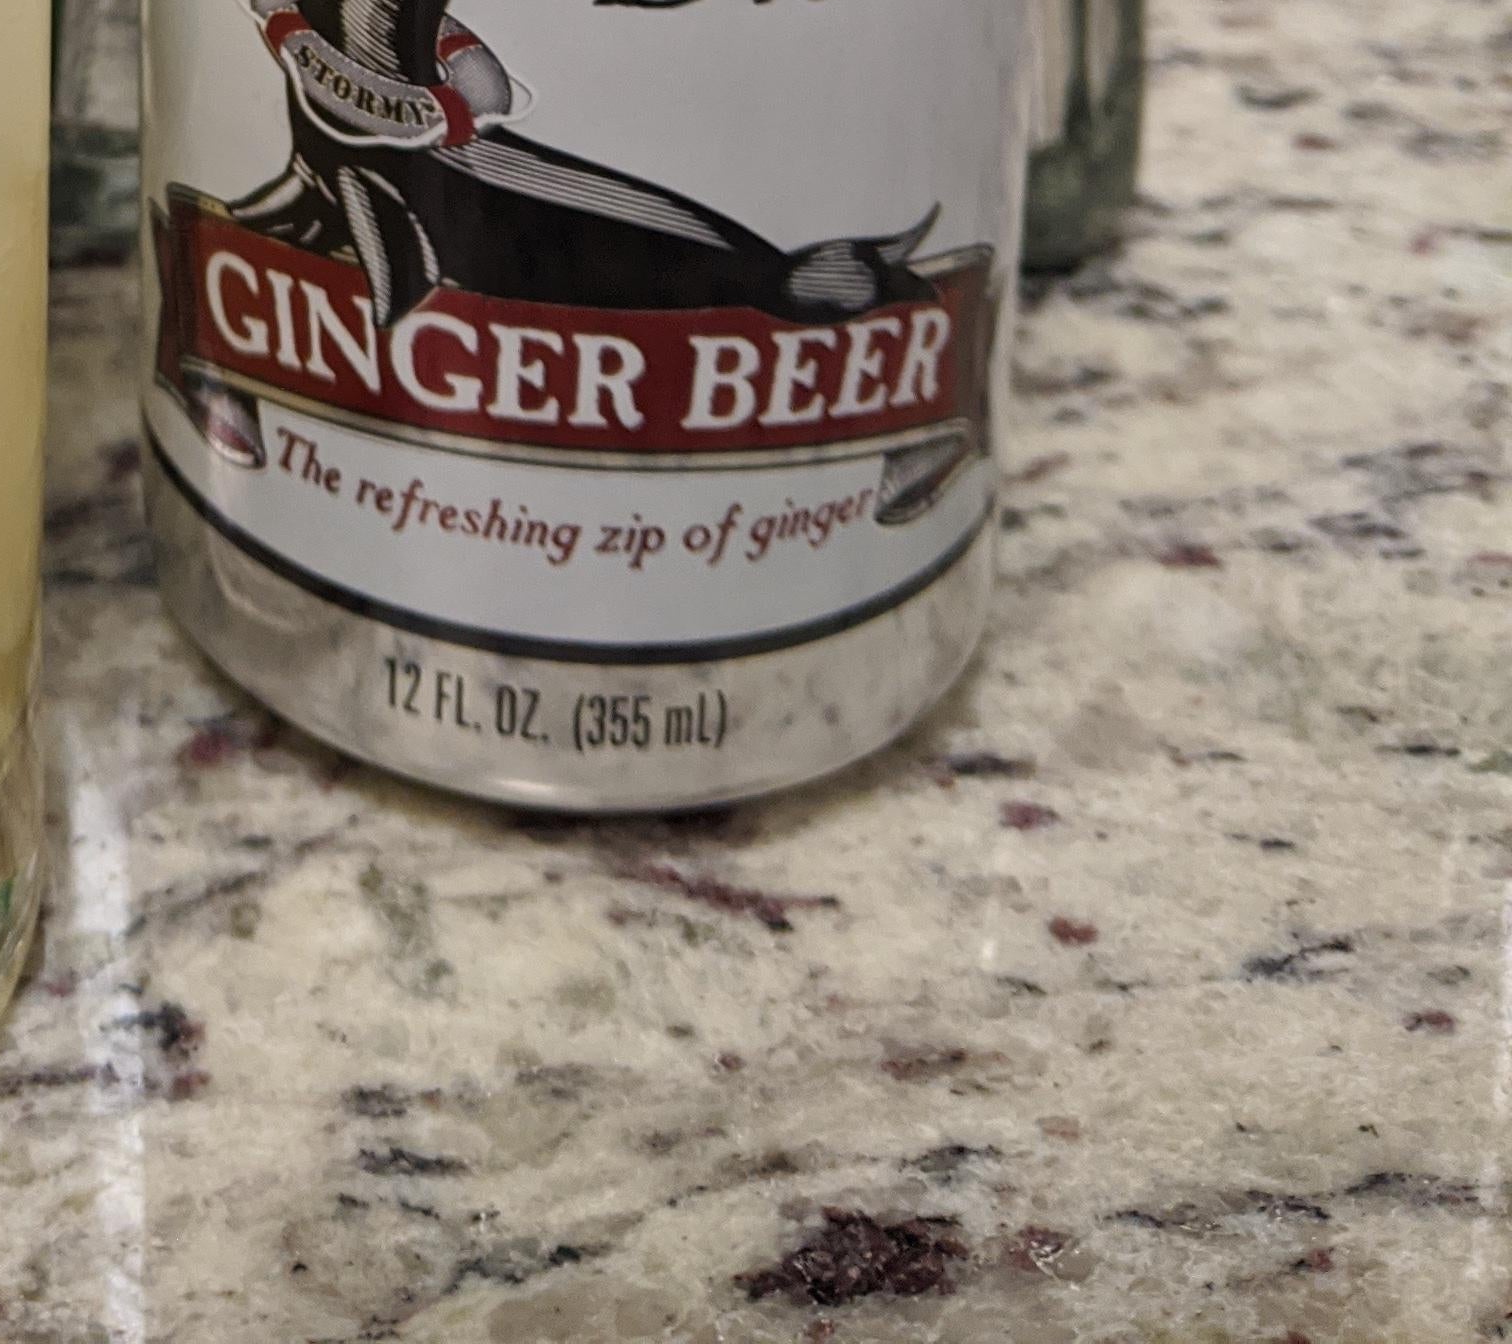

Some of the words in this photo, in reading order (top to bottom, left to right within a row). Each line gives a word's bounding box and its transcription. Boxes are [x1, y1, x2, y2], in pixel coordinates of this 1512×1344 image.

[295, 44, 436, 126] STORMY
[205, 251, 647, 432] GINGER
[681, 308, 953, 432] BEER
[277, 427, 342, 495] The
[355, 478, 583, 565] refreshing
[594, 513, 667, 570] zip
[682, 502, 743, 566] of
[745, 486, 874, 563] ginger
[384, 656, 422, 713] 12
[434, 672, 483, 734] FL.
[494, 686, 549, 745] OZ.
[573, 692, 652, 752] (355
[664, 689, 728, 748] mL)
